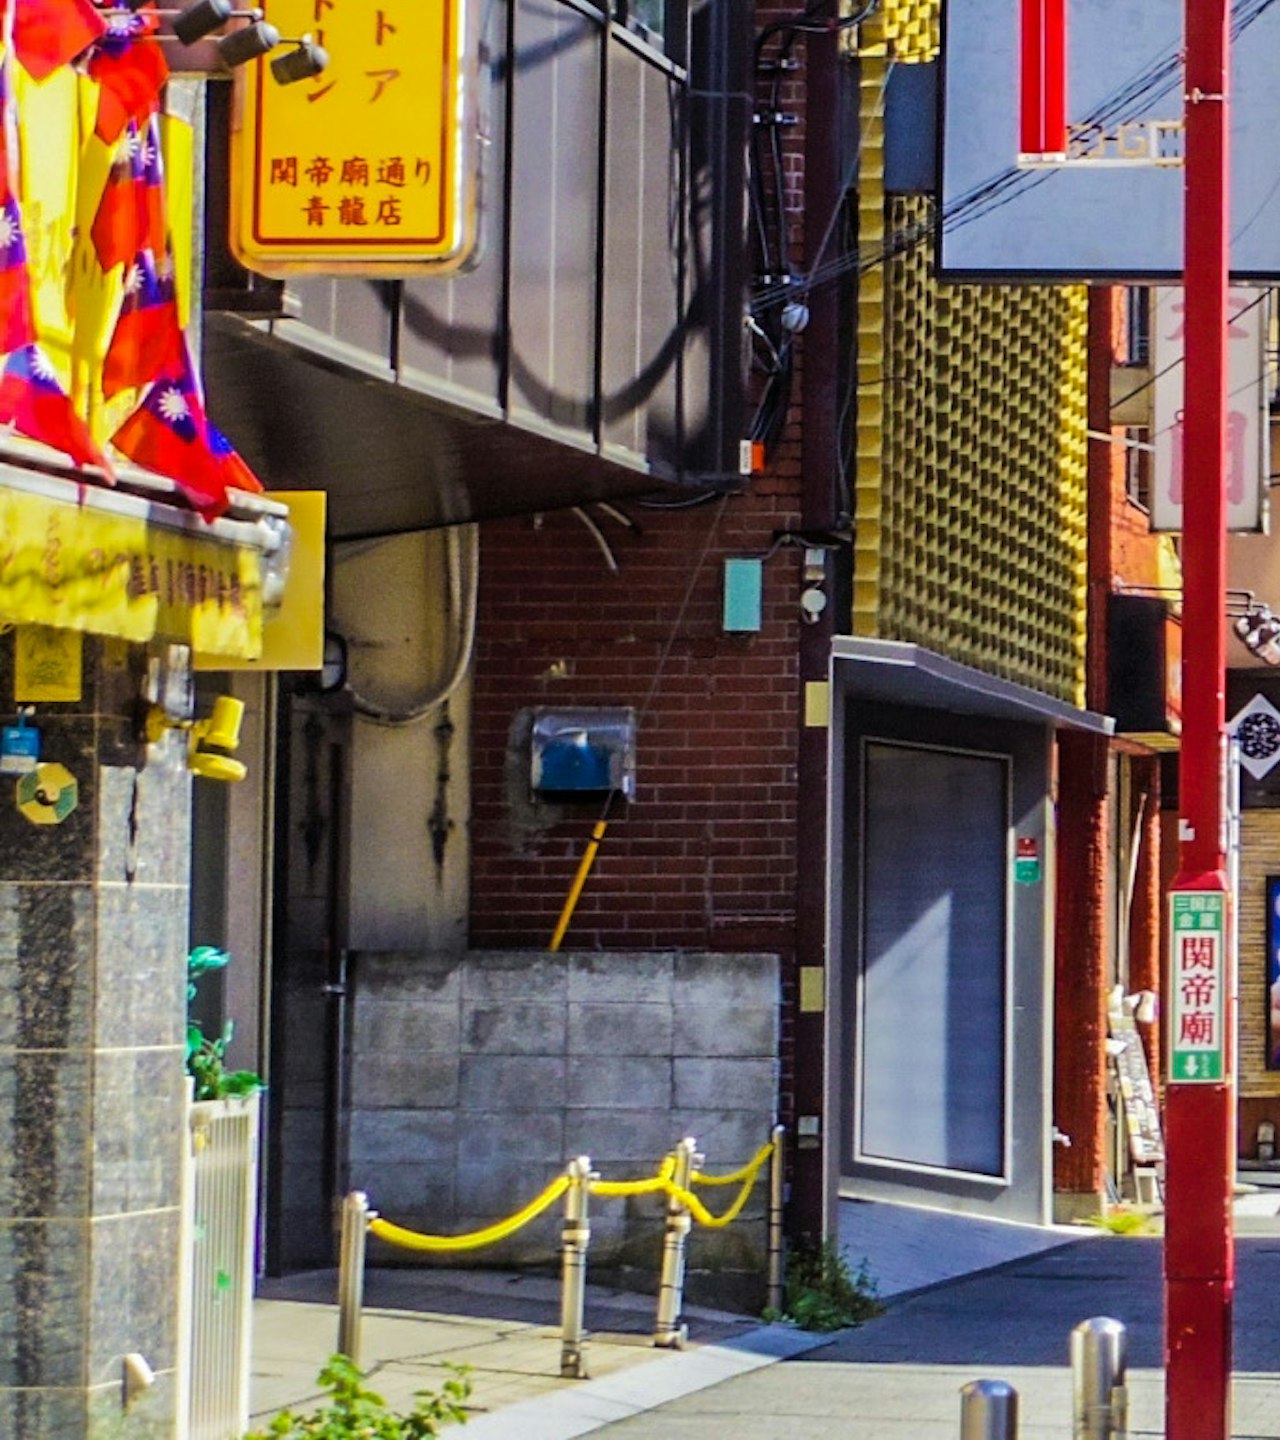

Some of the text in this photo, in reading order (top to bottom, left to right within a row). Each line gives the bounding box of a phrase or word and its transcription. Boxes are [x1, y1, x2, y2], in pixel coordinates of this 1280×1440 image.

[269, 156, 432, 188] 関帝廟通り
[300, 196, 404, 227] 青龍店
[1178, 936, 1217, 1046] 関帝廟
